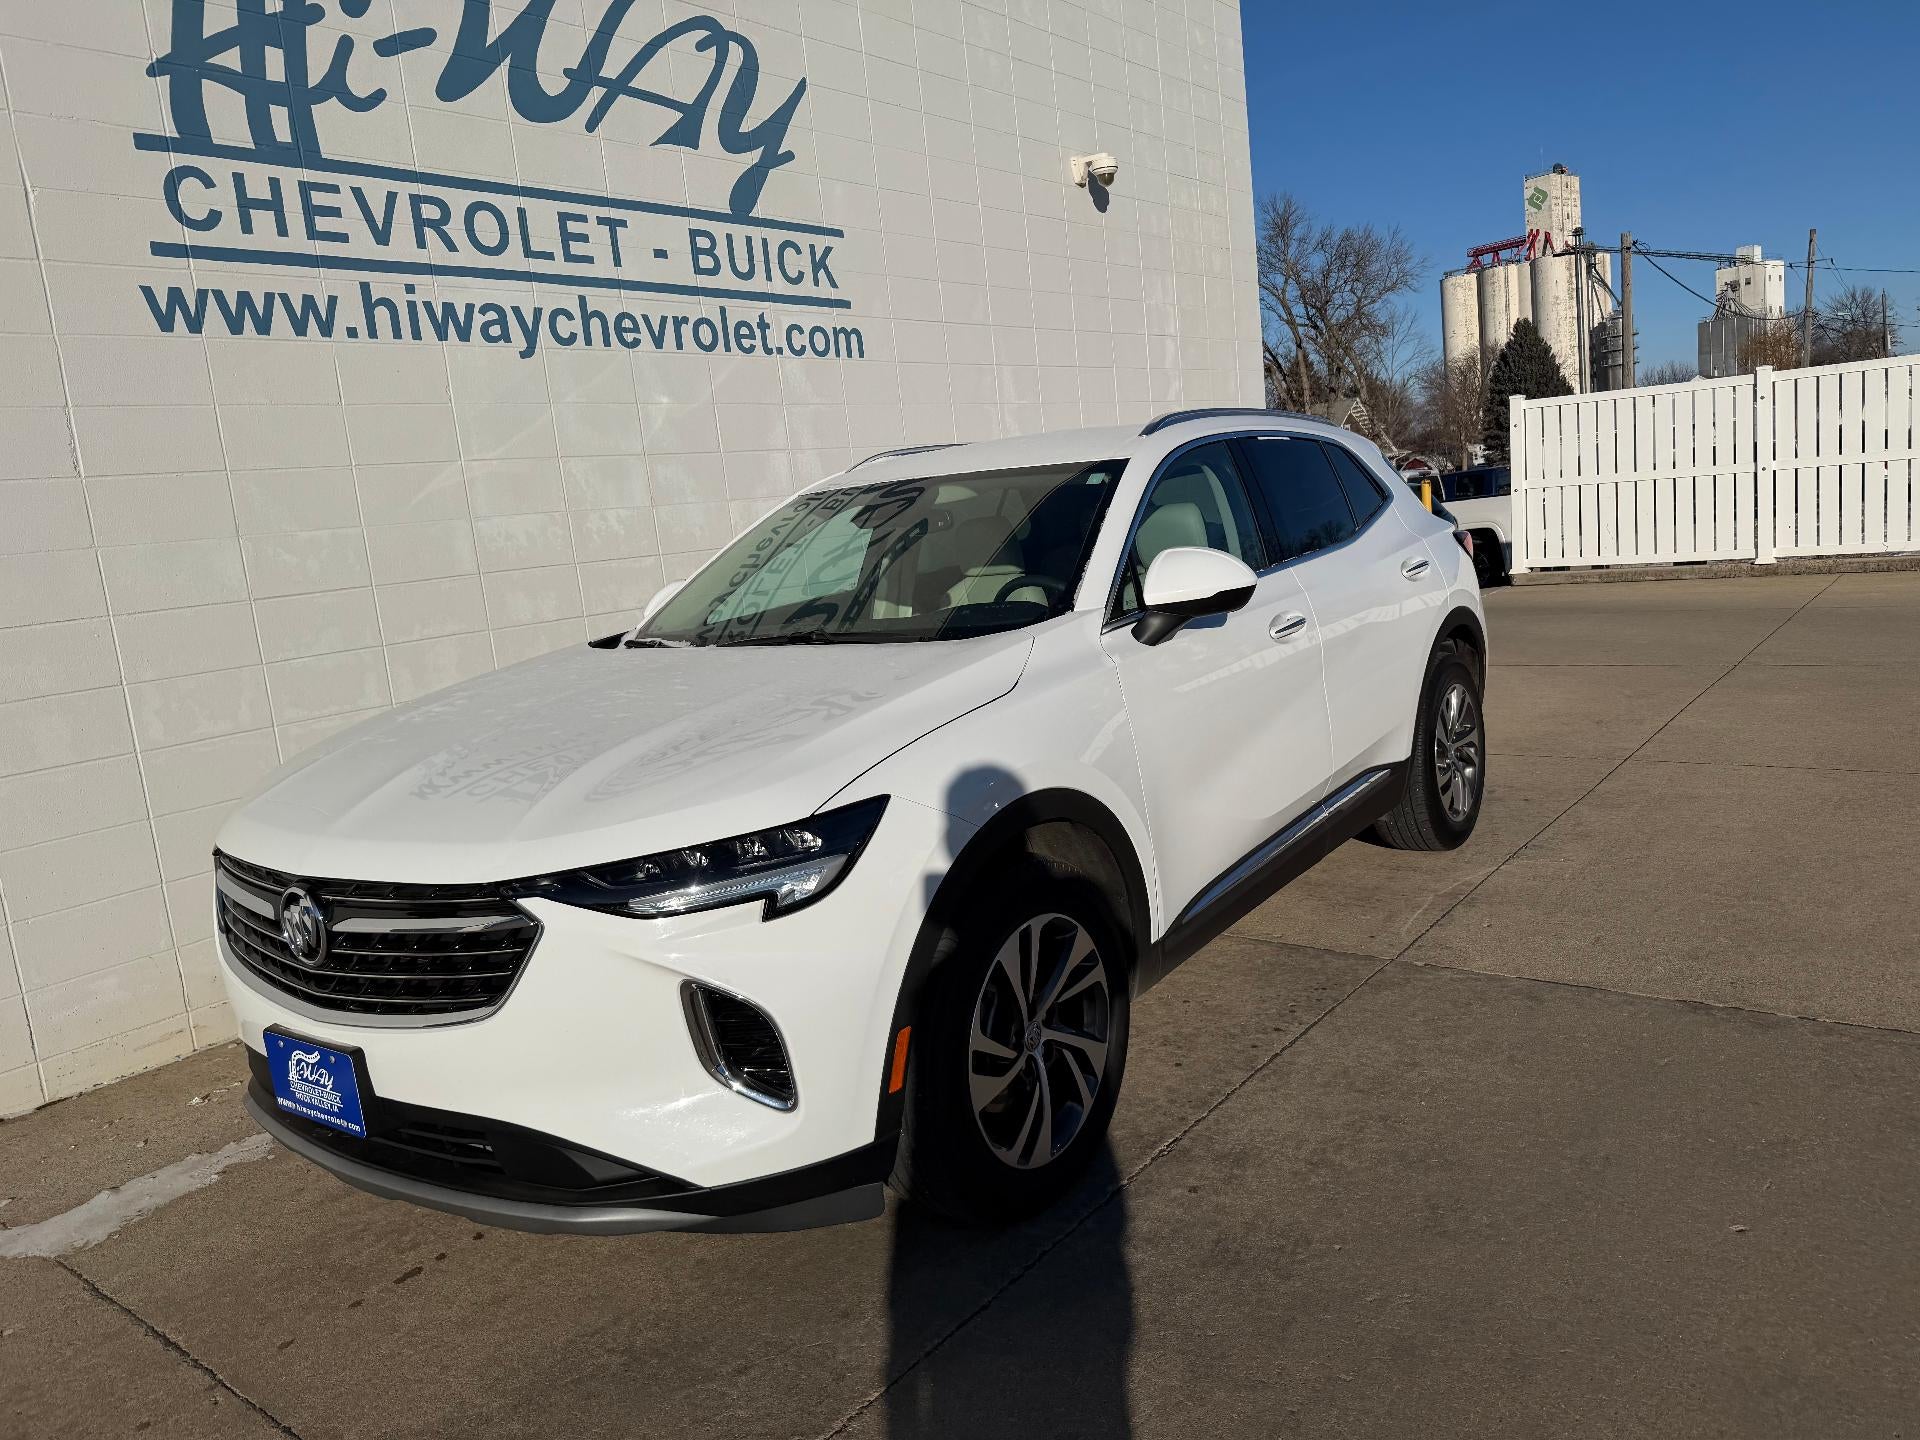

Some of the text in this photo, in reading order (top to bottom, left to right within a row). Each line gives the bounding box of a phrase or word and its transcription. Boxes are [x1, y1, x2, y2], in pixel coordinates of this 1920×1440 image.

[163, 165, 629, 267] CHEVROLET
[688, 228, 839, 289] BUICK
[139, 281, 865, 359] www.hiwaychevrolet.com
